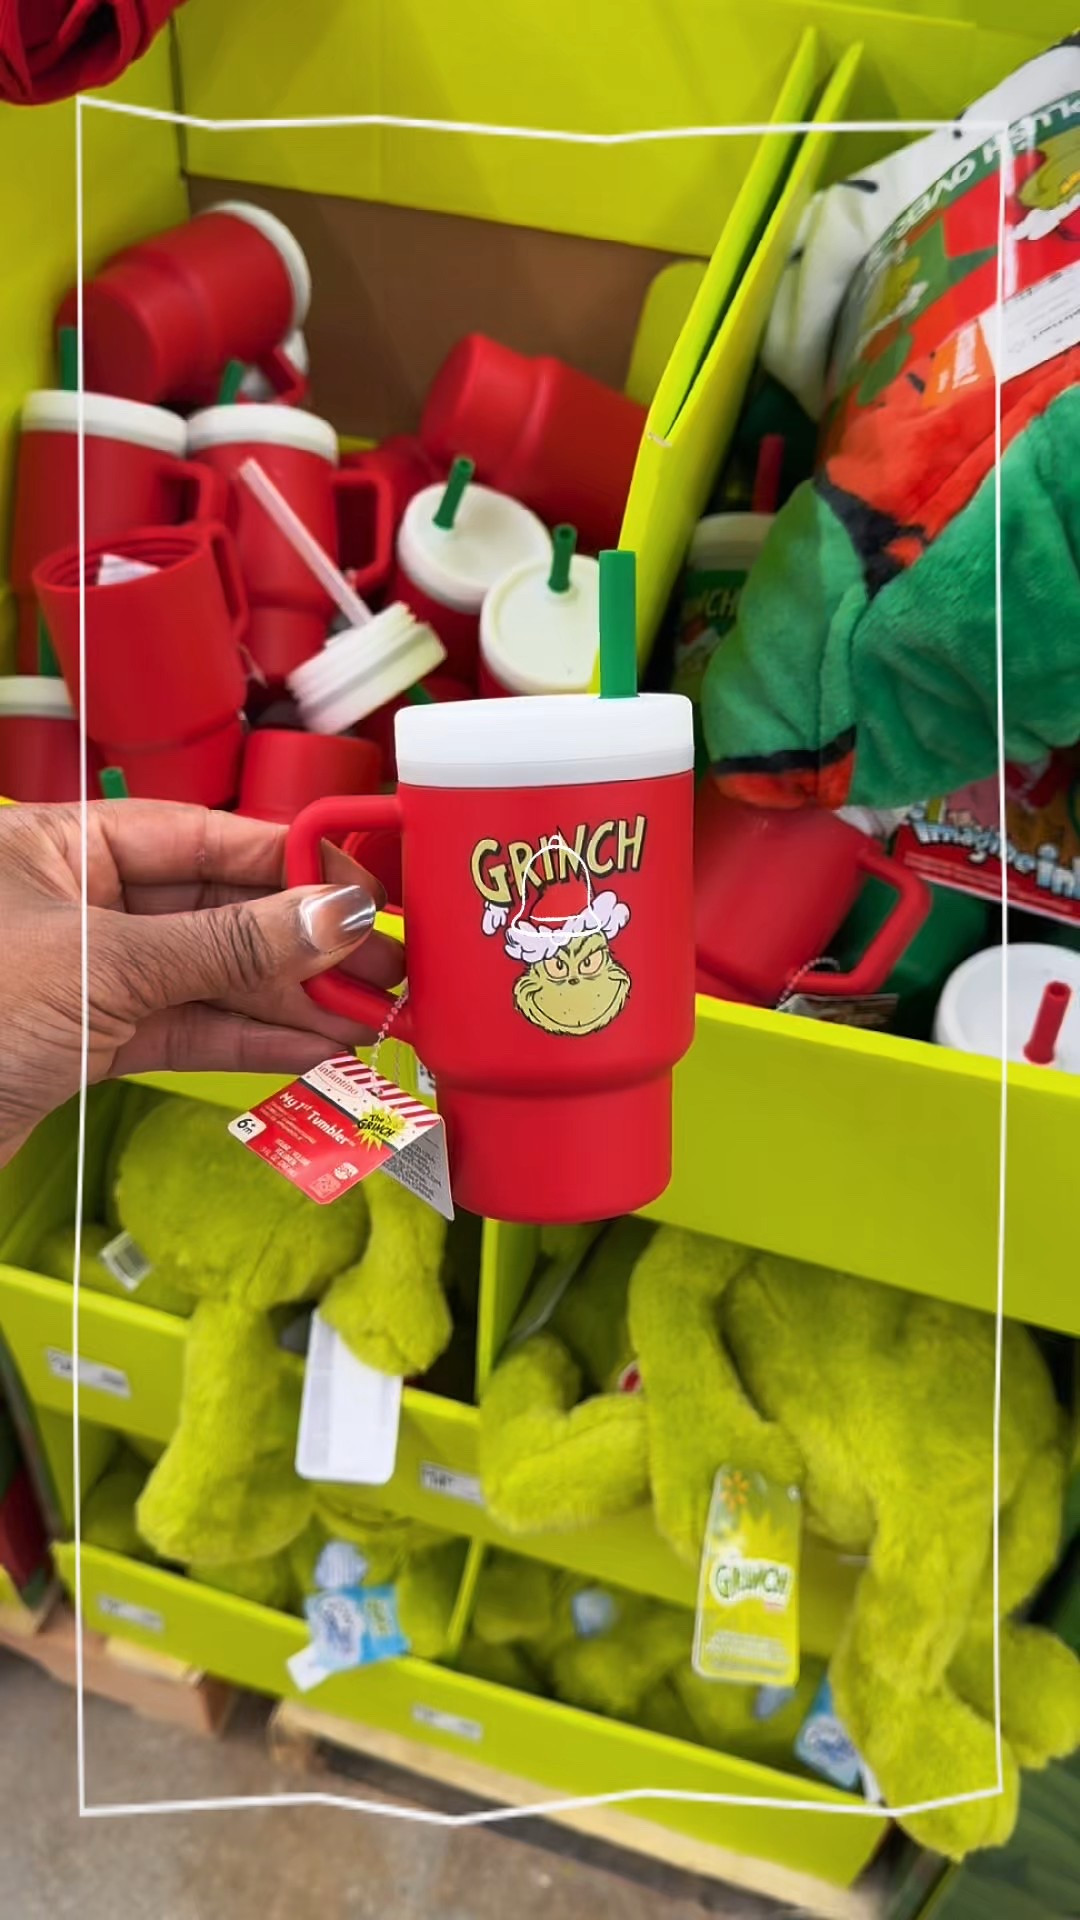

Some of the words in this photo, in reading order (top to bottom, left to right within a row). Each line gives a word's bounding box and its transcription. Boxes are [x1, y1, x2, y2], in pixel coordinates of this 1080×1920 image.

[470, 813, 647, 907] GRINCH
[317, 1064, 359, 1096] infantino
[280, 1091, 298, 1109] My
[369, 1114, 384, 1123] The
[357, 1119, 395, 1137] GRINCH
